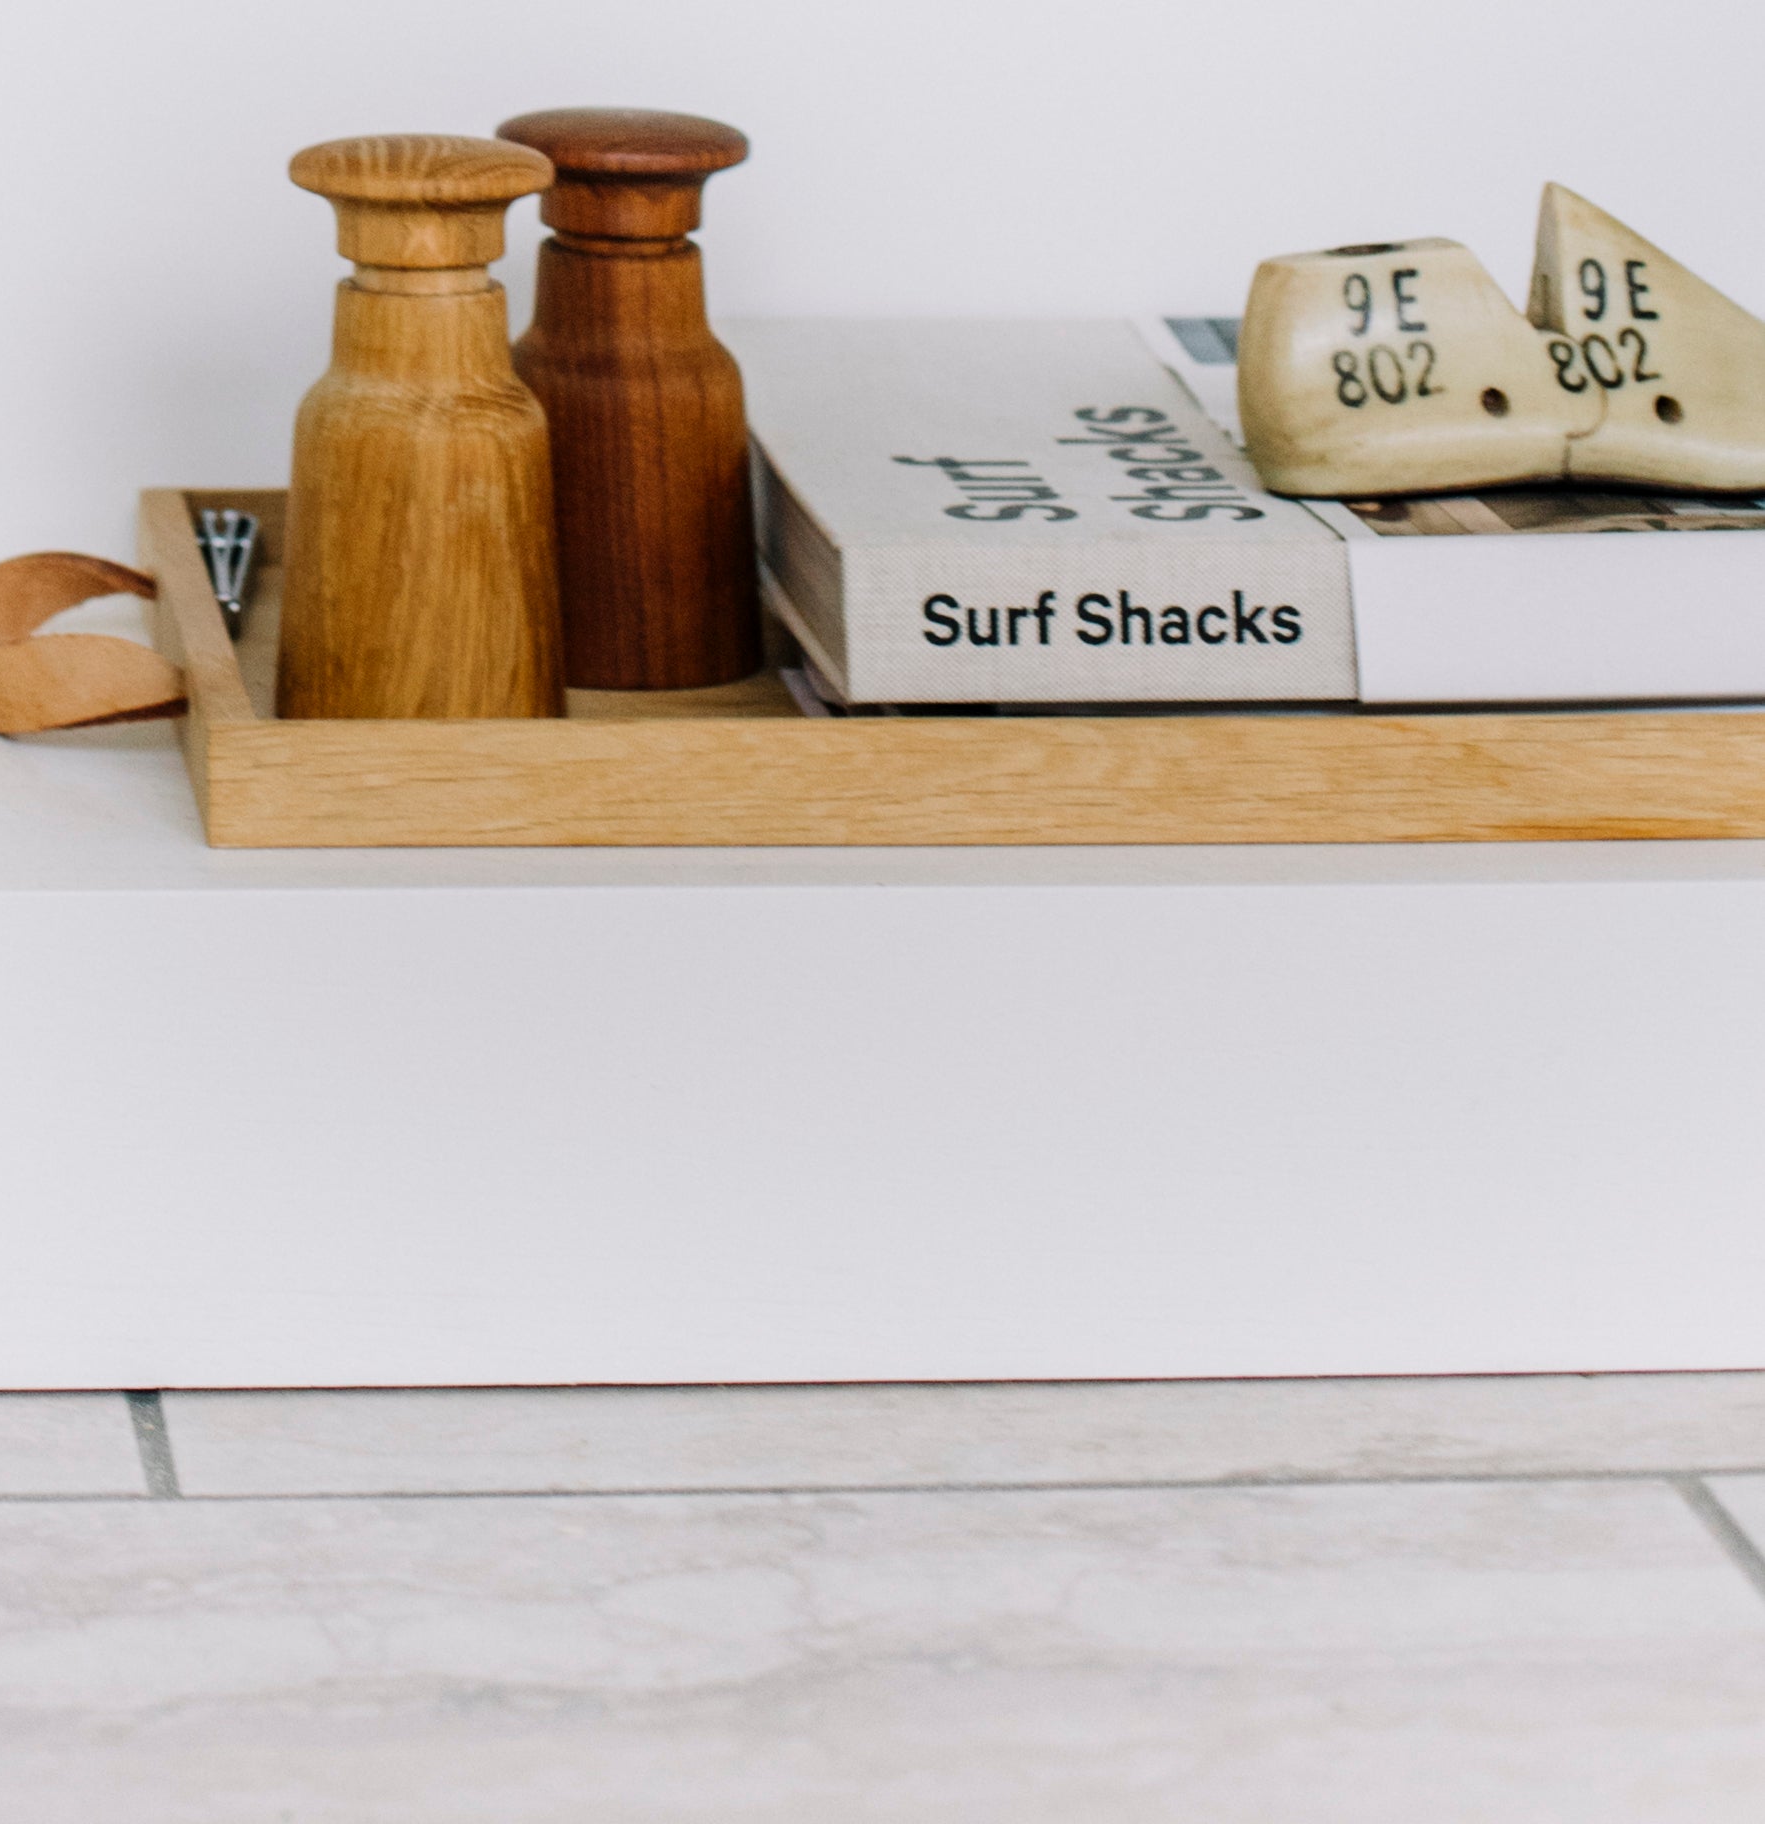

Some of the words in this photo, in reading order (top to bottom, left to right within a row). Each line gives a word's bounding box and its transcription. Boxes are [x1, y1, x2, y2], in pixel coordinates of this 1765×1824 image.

[1343, 273, 1372, 336] 9
[1393, 268, 1428, 332] E
[1579, 258, 1606, 321] 9
[1626, 260, 1659, 322] E
[1333, 341, 1446, 408] 802
[1547, 327, 1661, 394] 802
[890, 454, 1078, 522] Surf
[1056, 406, 1265, 522] Shacks
[922, 590, 1056, 646] Surf
[1076, 590, 1302, 646] Shacks
